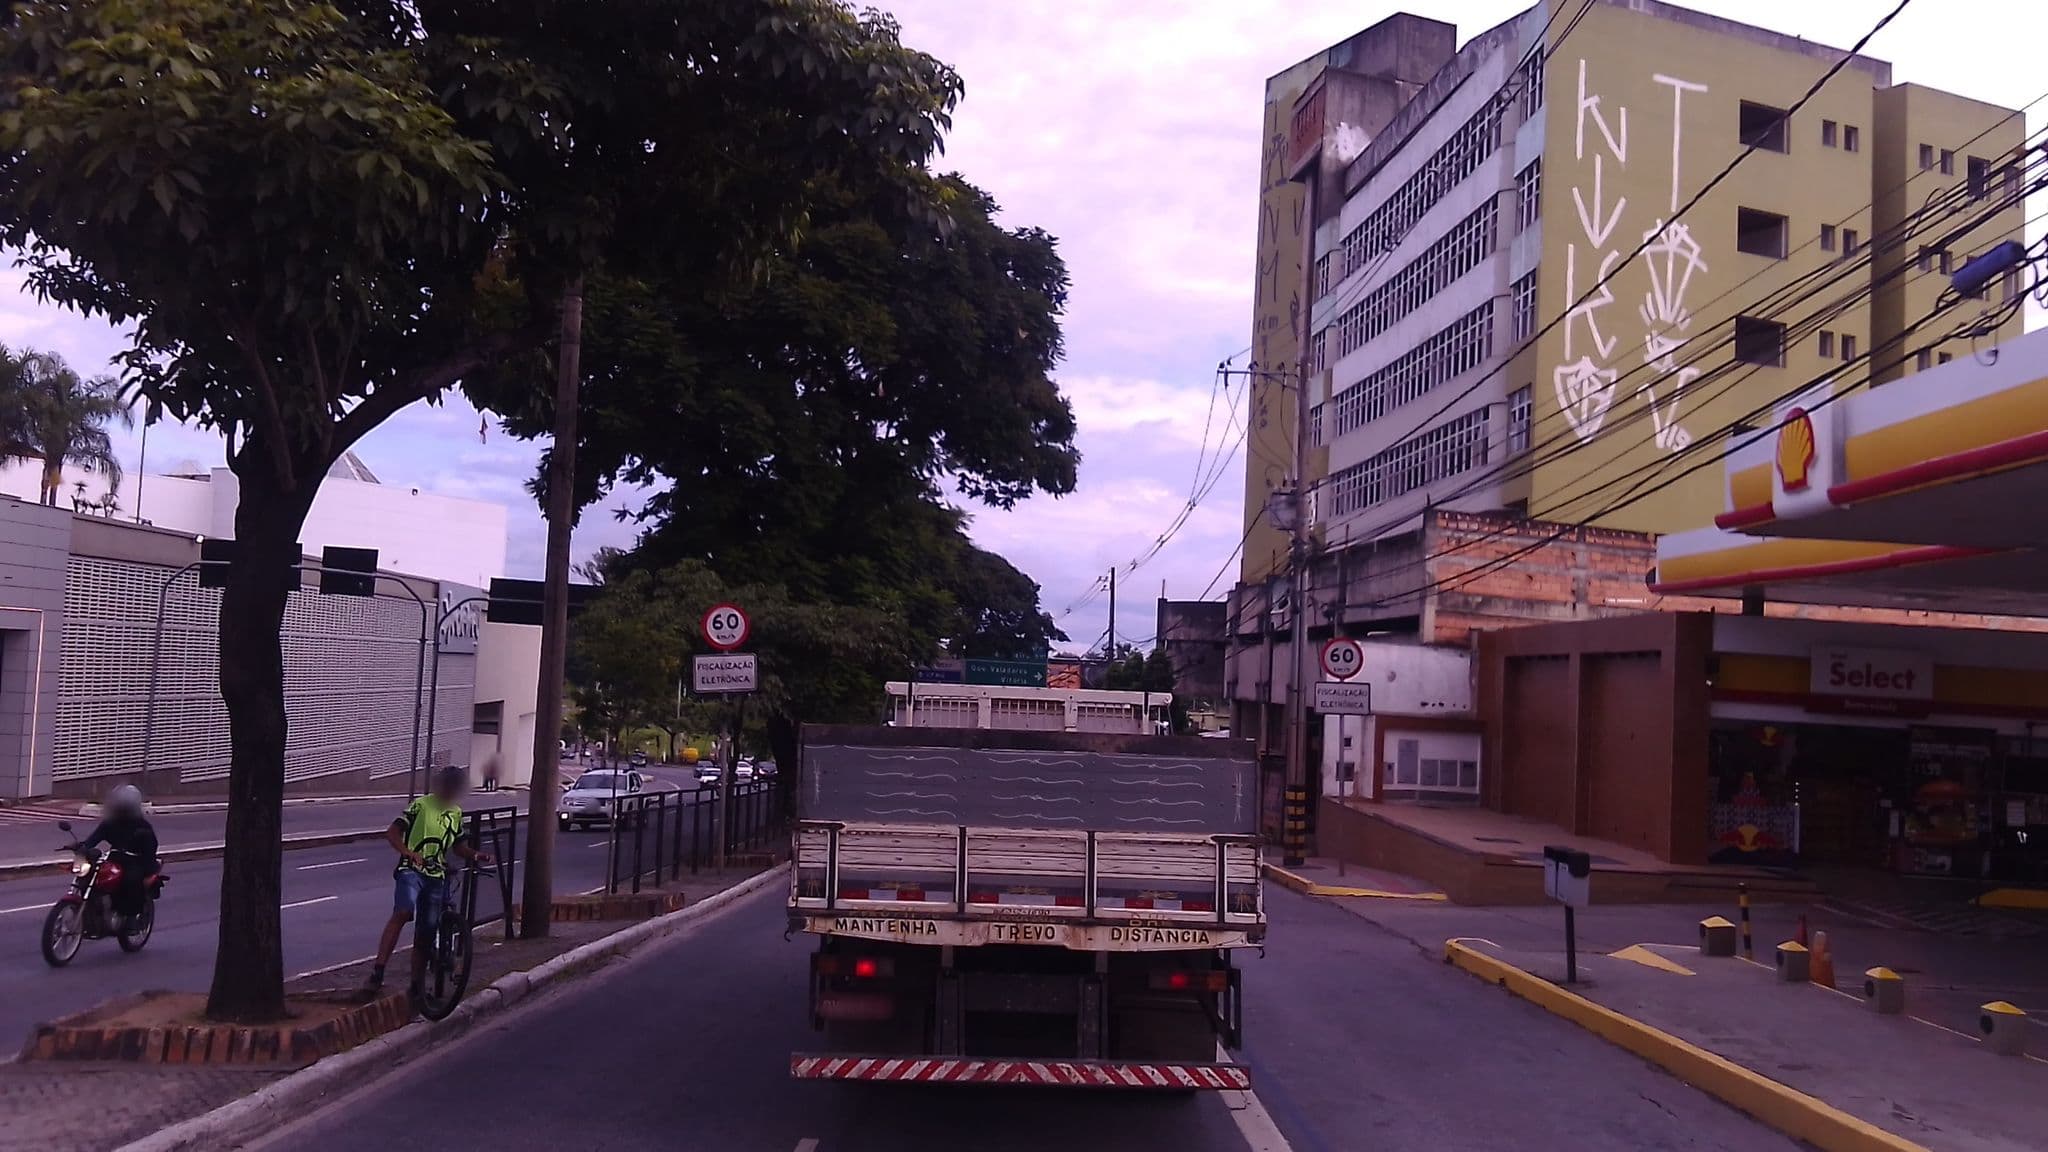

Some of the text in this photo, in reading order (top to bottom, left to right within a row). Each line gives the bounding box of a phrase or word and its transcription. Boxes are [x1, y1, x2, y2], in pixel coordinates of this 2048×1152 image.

[712, 614, 739, 630] 60
[1330, 648, 1354, 663] 60
[1830, 662, 1916, 690] Select
[835, 919, 937, 935] MANTENHA
[993, 924, 1055, 940] TREVO
